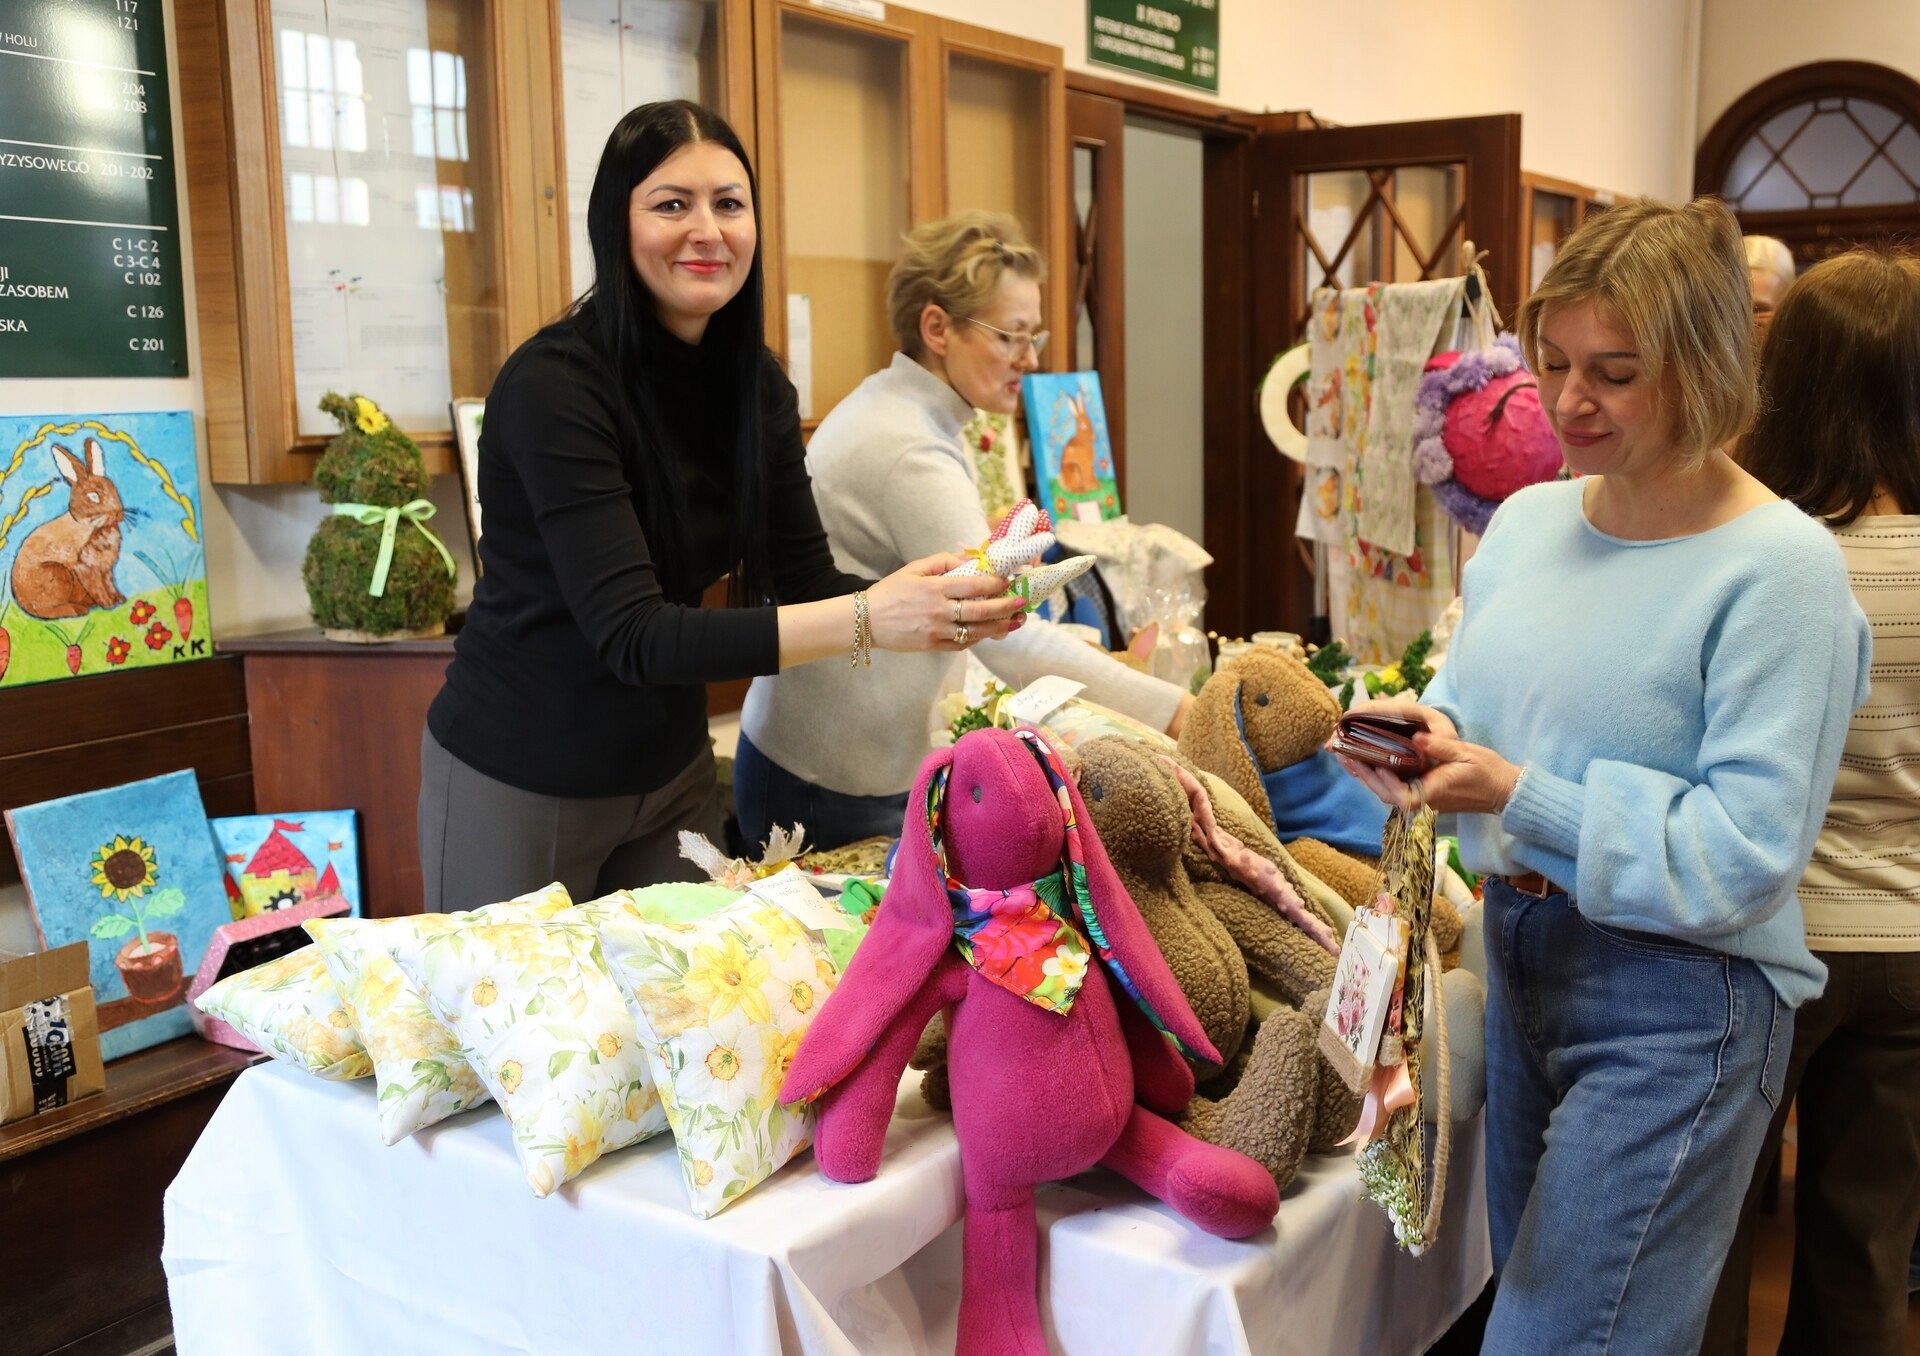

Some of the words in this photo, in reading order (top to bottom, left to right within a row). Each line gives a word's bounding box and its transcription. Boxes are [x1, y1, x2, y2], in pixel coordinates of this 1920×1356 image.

[117, 16, 138, 31] 121
[5, 33, 38, 48] HOLU
[122, 82, 146, 97] 204
[100, 162, 154, 180] 201-202
[112, 238, 122, 250] C
[113, 255, 123, 267] C
[124, 272, 135, 285] C
[139, 273, 161, 286] 102
[0, 284, 69, 299] ZASOBEM
[126, 305, 137, 318] C
[142, 306, 164, 319] 126
[0, 319, 28, 332] SKA
[129, 338, 139, 351] C
[142, 338, 164, 351] 201
